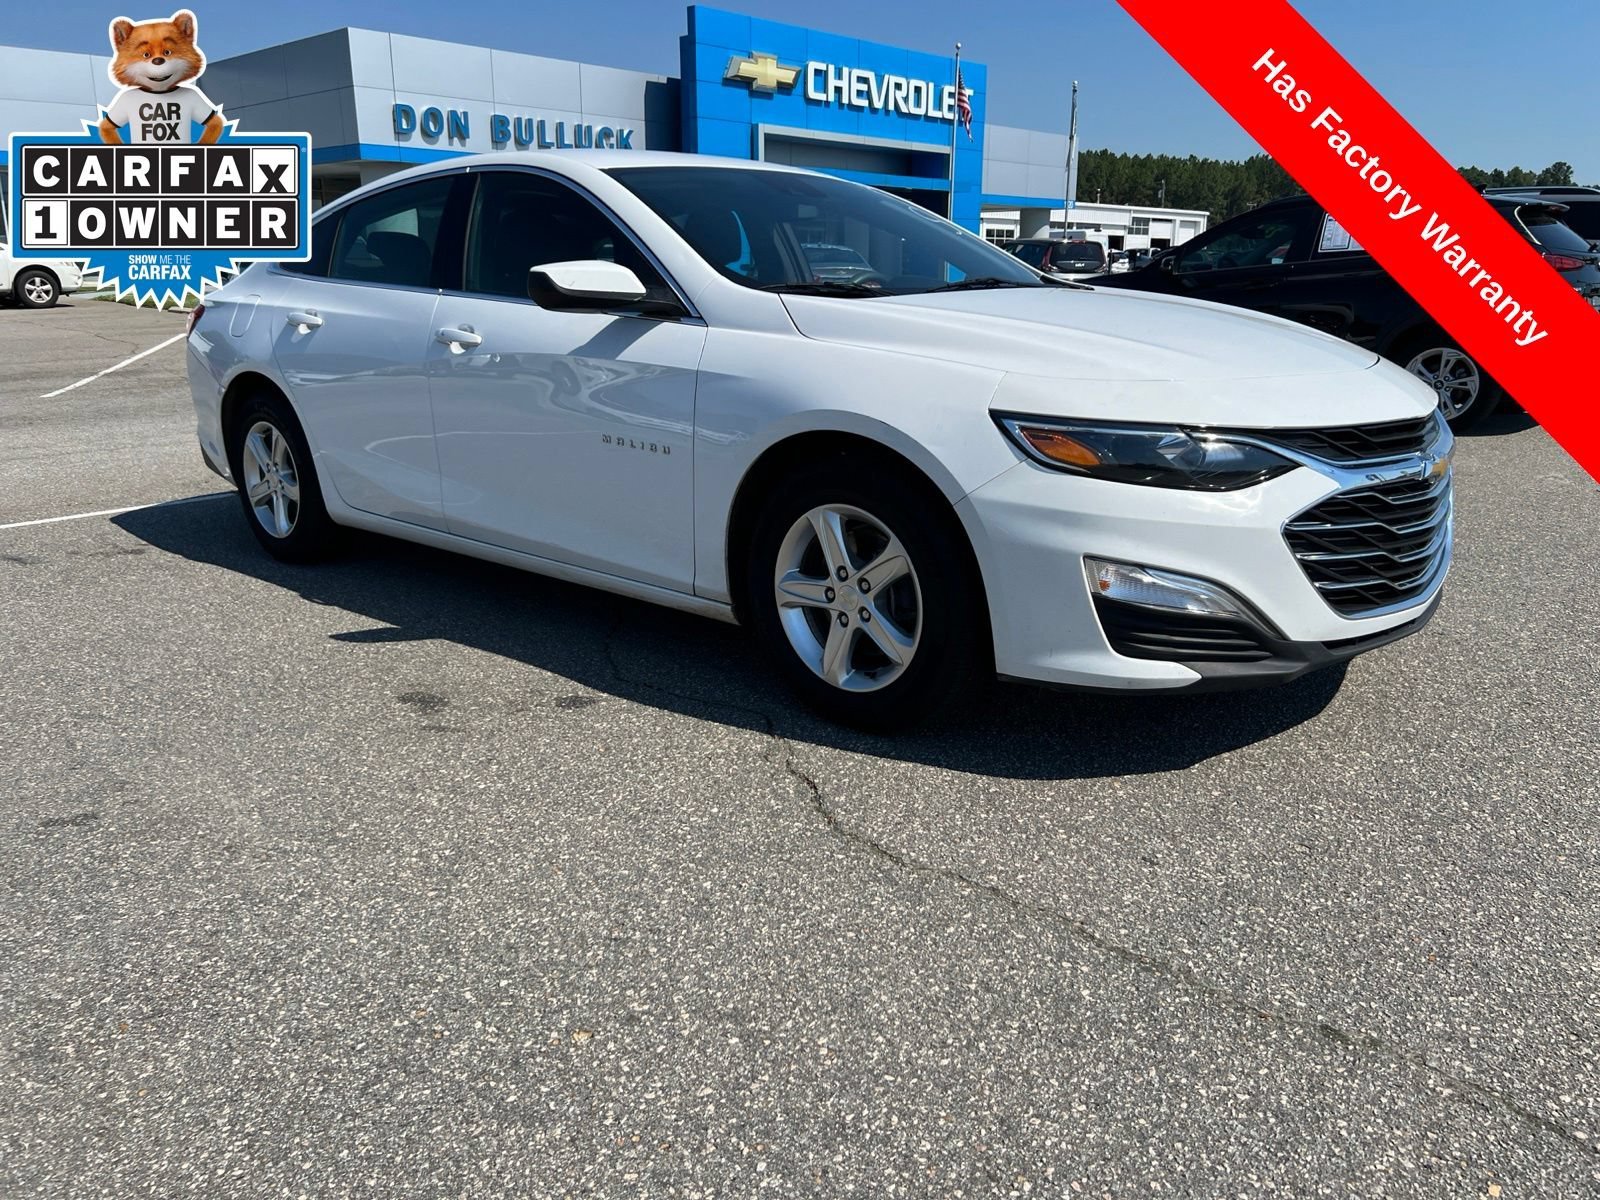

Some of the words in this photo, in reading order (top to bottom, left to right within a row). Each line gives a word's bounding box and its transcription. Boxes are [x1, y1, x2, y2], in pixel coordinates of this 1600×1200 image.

[393, 103, 470, 139] DON
[491, 114, 633, 151] BULLUCK
[602, 433, 671, 455] MALIBU
